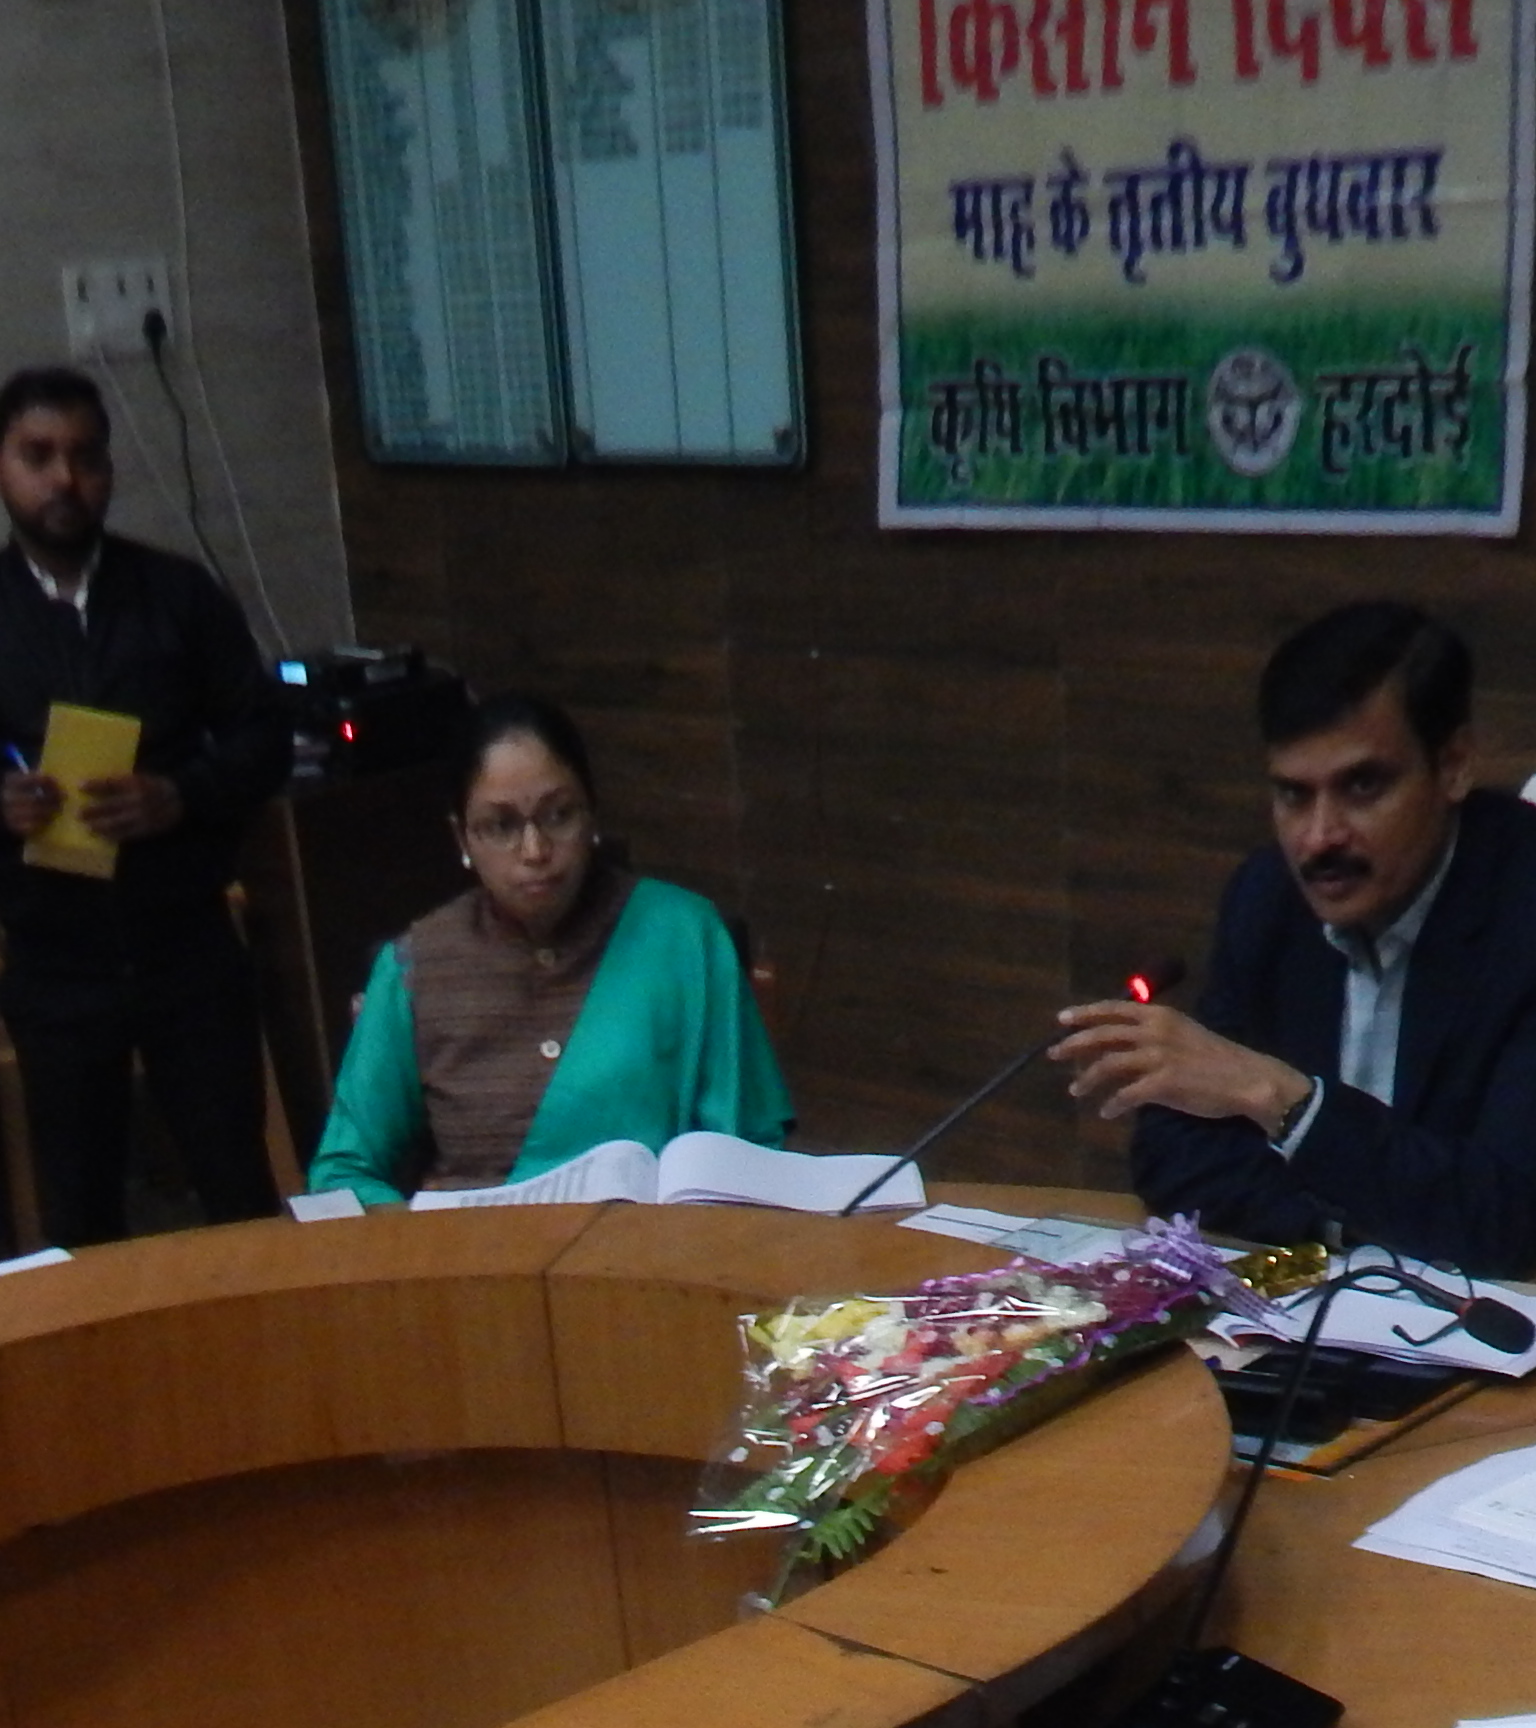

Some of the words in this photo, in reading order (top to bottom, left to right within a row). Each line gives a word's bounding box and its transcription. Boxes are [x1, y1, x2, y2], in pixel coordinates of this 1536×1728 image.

[948, 174, 1037, 279] माह
[1045, 144, 1092, 256] के
[1102, 132, 1252, 285] तृतीय
[927, 357, 1023, 485] कृषि
[1316, 344, 1473, 476] हरदोई
